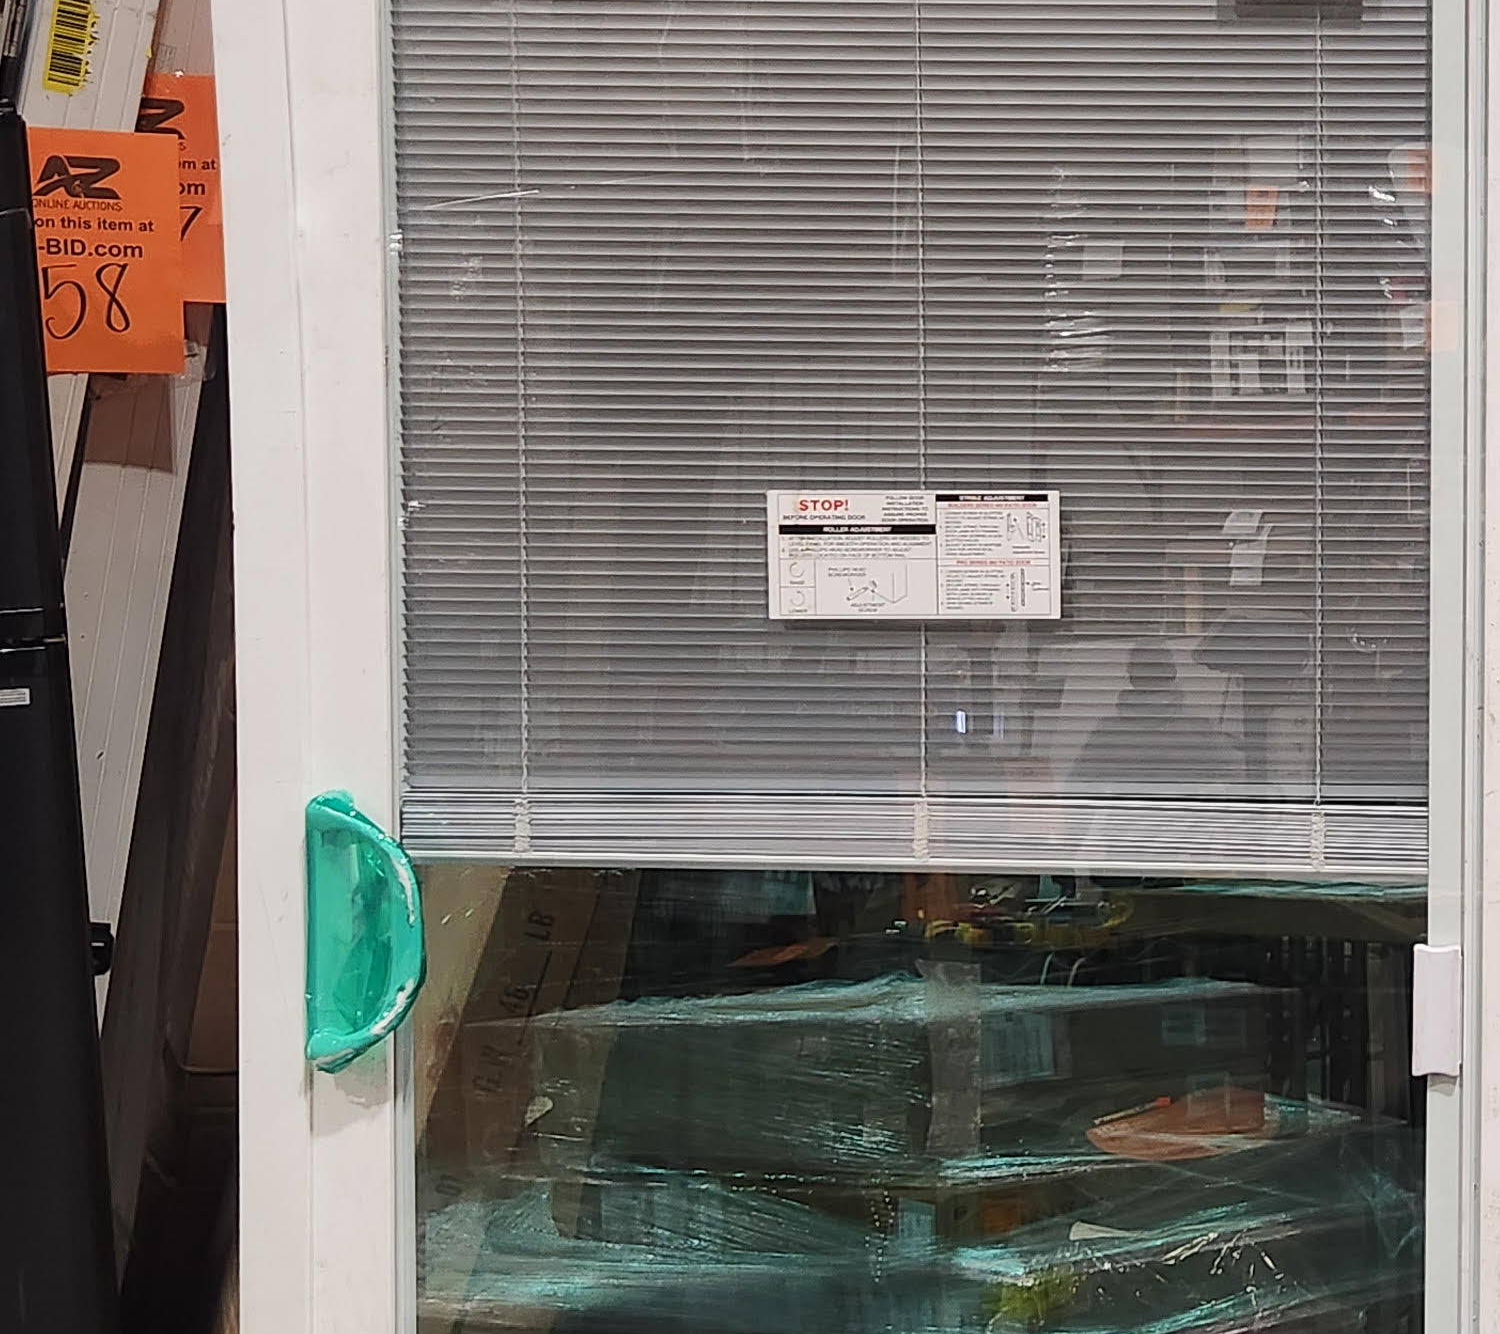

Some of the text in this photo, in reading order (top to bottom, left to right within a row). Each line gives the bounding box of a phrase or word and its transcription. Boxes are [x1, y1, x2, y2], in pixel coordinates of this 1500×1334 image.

[202, 159, 217, 171] at
[33, 199, 122, 212] ONLINE AUCTIONS
[36, 216, 154, 232] on this item at
[799, 499, 849, 512] STOP!
